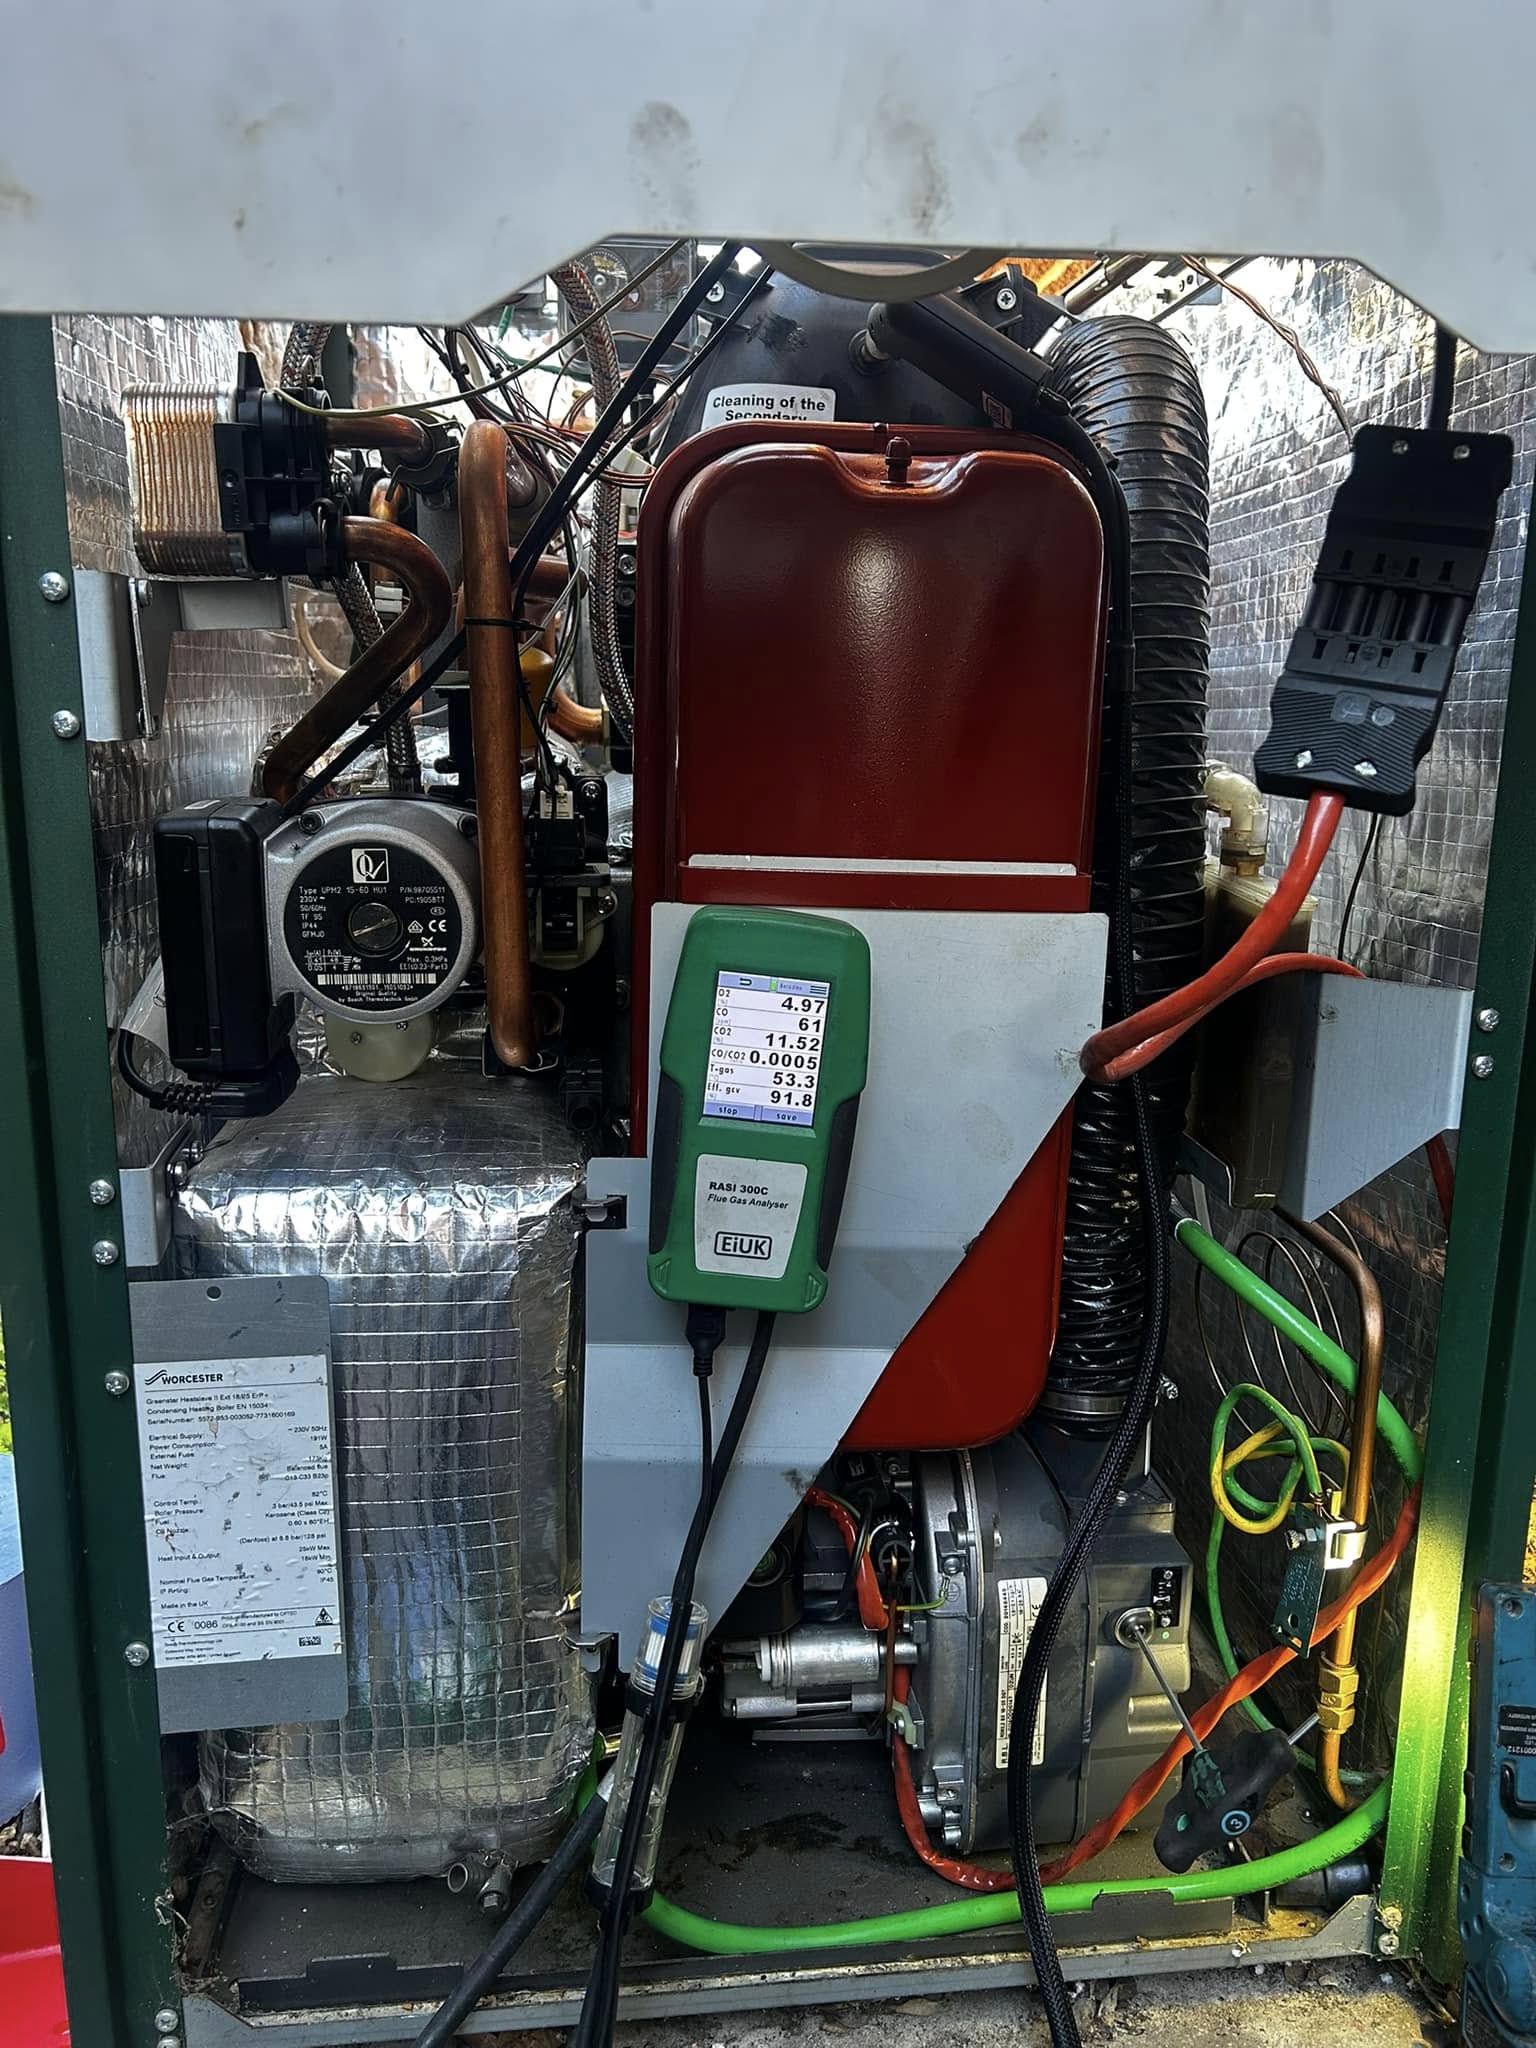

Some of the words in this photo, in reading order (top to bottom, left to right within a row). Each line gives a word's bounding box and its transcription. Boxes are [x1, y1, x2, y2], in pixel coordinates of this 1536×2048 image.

[713, 394, 774, 410] Cleaning
[780, 397, 796, 408] of
[801, 398, 826, 412] the
[299, 886, 317, 895] Type
[321, 886, 342, 894] UPM2
[346, 886, 369, 894] 15-60
[718, 989, 731, 998] O2
[781, 997, 825, 1014] 4.97
[716, 1008, 728, 1017] CO
[798, 1018, 821, 1033] 61
[714, 1027, 732, 1036] CO2
[765, 1033, 820, 1052] 11.52
[712, 1049, 746, 1060] CO/CO2
[750, 1050, 818, 1070] 0.0005
[772, 1071, 816, 1089] 53.3
[770, 1090, 813, 1108] 91.8
[718, 1106, 738, 1116] stop
[776, 1112, 798, 1121] save
[709, 1181, 736, 1192] RASI
[740, 1184, 768, 1196] 300C
[708, 1194, 728, 1204] Flue
[730, 1196, 747, 1205] Gas
[749, 1198, 790, 1210] Analyser
[722, 1236, 768, 1256] EiUK
[162, 1373, 224, 1384] WORCESTER
[168, 1621, 185, 1632] CE
